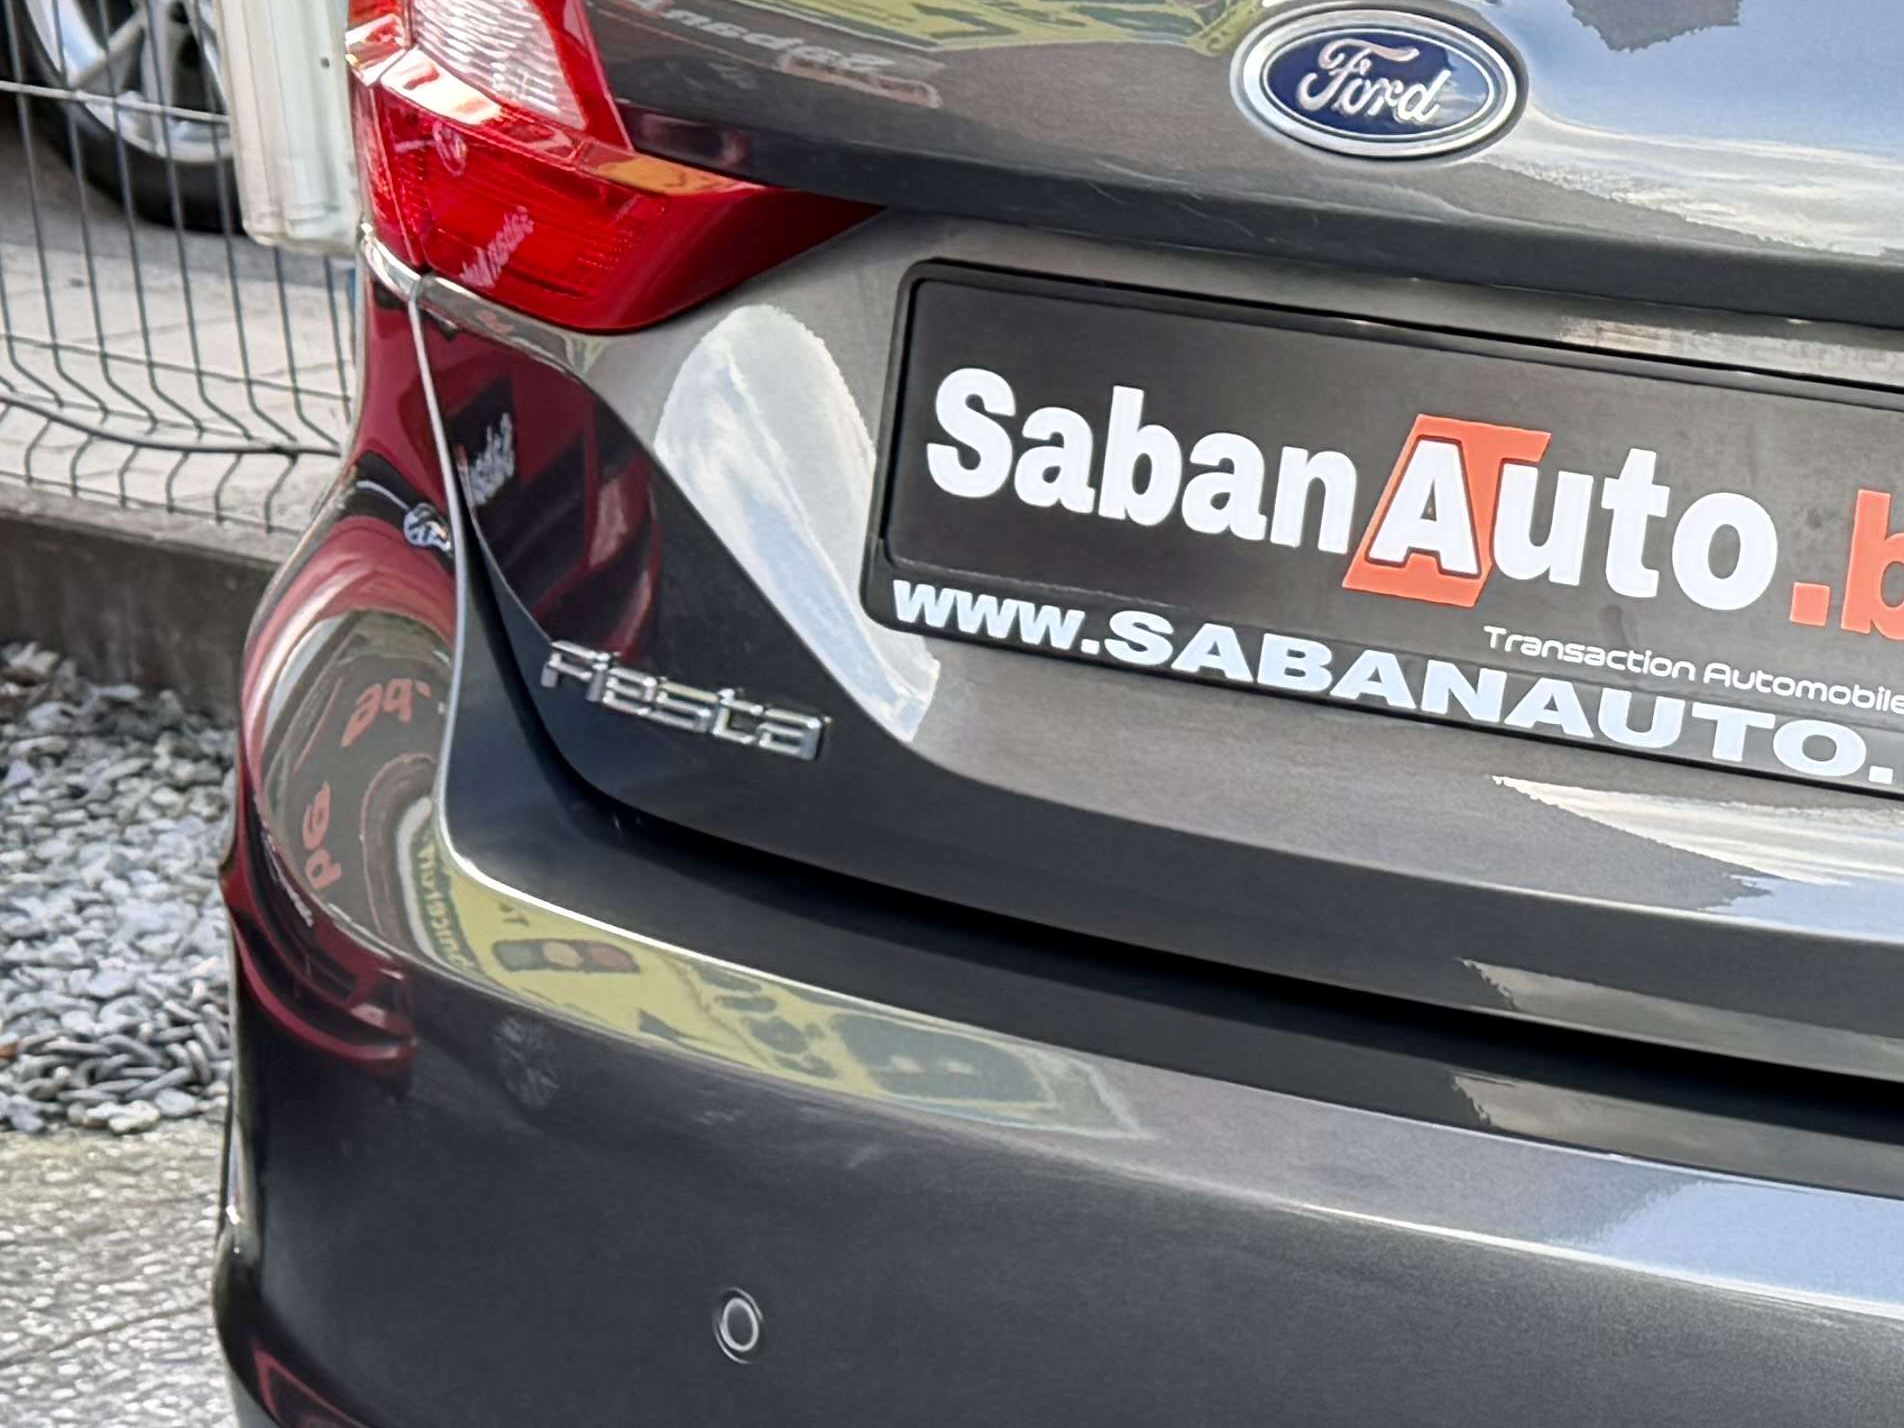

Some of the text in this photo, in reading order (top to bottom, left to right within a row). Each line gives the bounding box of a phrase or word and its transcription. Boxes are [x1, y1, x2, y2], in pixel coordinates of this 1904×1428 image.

[1297, 37, 1451, 124] Ford
[1483, 625, 1696, 682] Transaction
[540, 640, 826, 760] Fiesta
